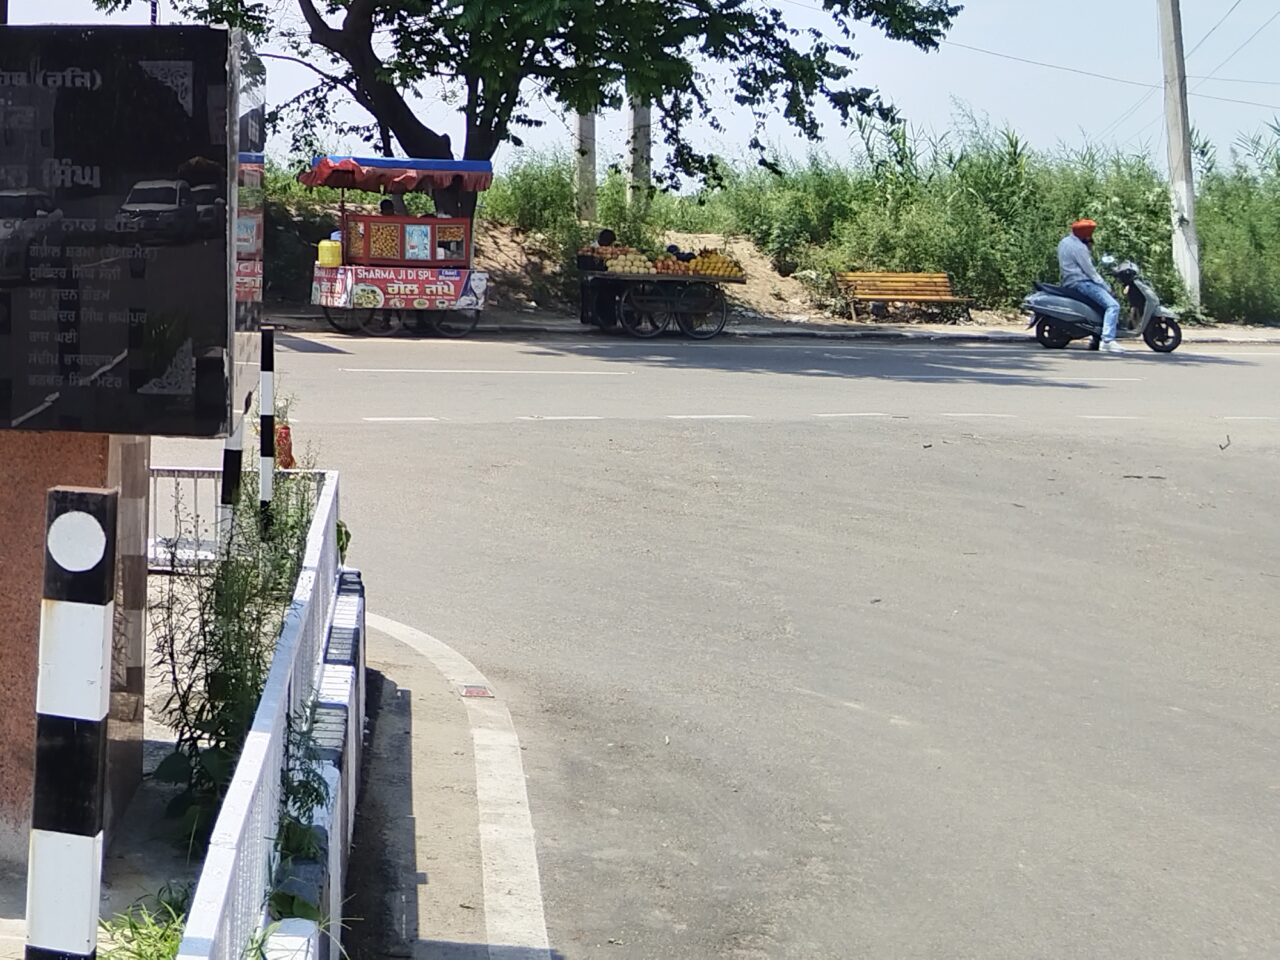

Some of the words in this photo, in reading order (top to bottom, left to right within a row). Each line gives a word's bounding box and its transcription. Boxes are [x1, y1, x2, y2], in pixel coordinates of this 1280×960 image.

[398, 269, 406, 280] JI
[407, 270, 417, 280] DI
[386, 280, 419, 295] ਗੋਲ
